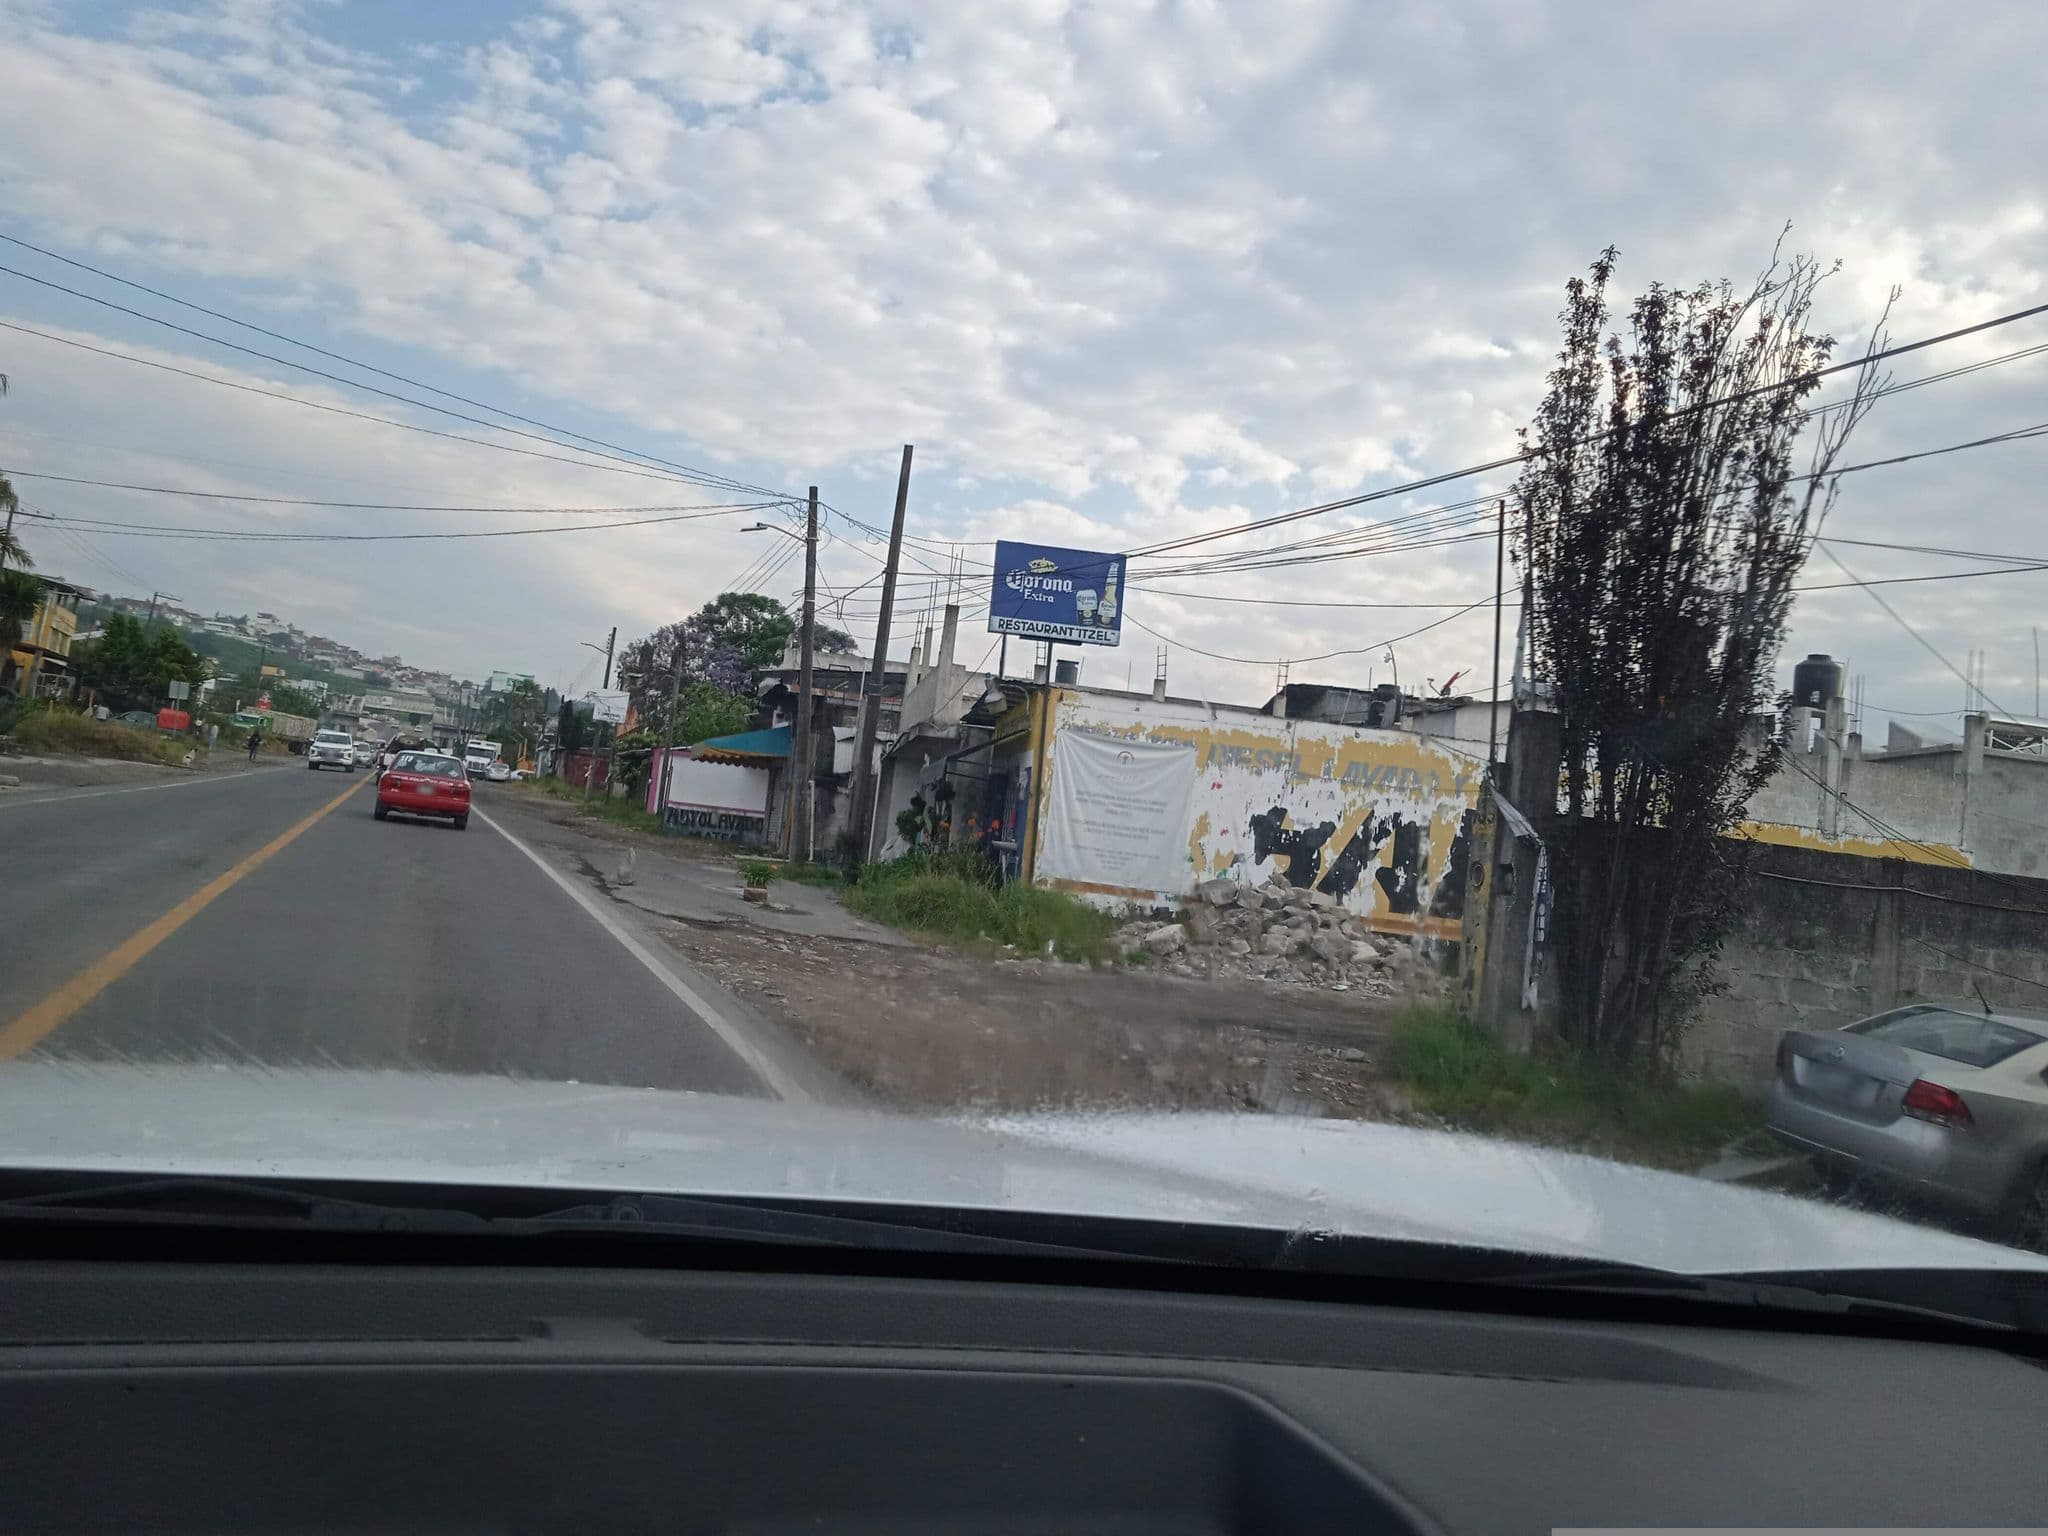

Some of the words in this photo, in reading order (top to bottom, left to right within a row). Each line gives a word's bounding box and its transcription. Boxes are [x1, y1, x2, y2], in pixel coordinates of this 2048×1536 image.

[1006, 569, 1073, 593] Corona
[1024, 590, 1054, 603] Extra
[998, 619, 1075, 637] RESTAURANT
